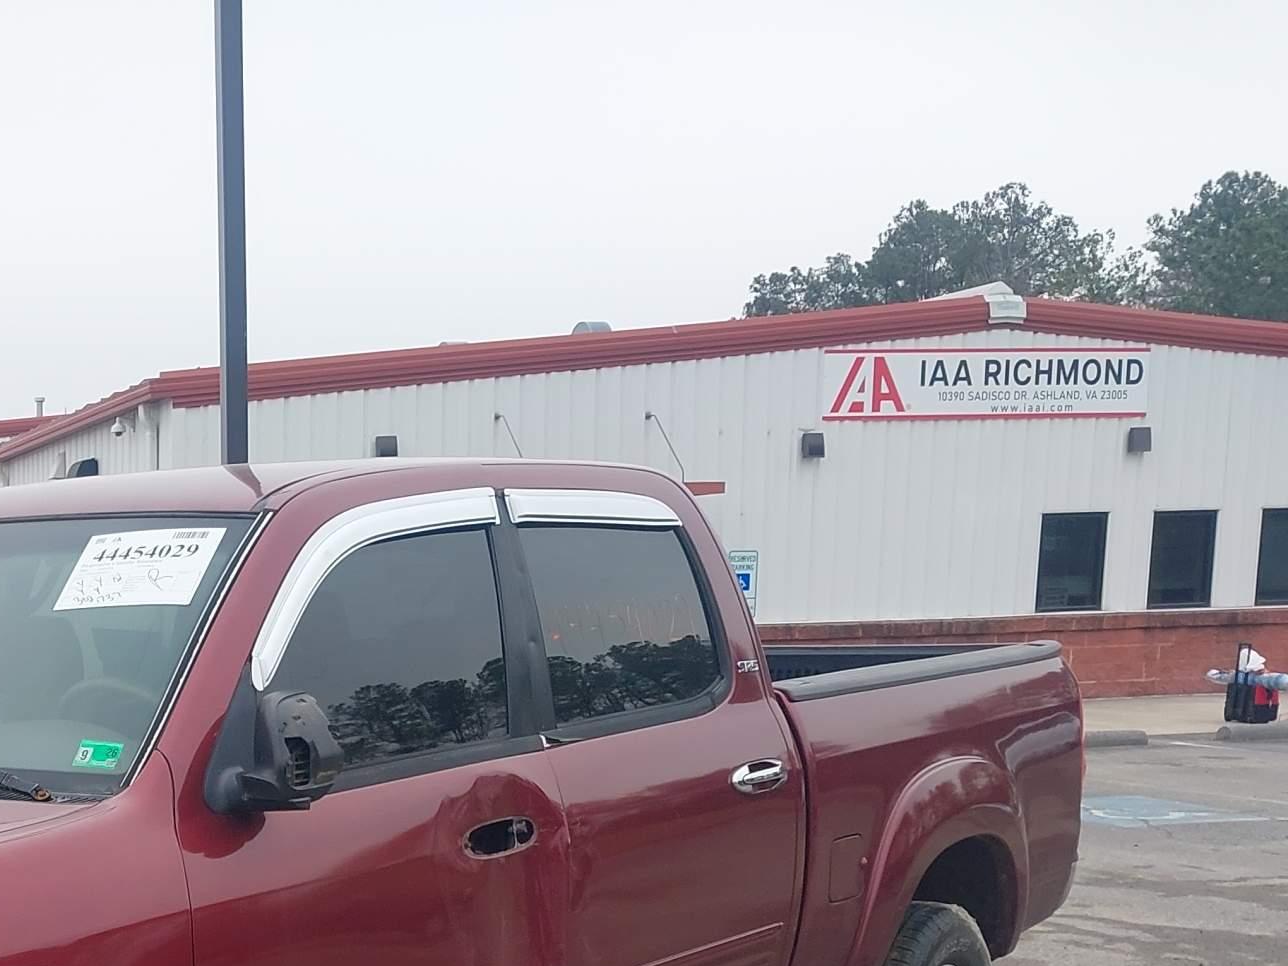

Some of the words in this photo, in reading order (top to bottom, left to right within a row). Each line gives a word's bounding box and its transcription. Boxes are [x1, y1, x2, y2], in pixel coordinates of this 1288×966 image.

[919, 359, 973, 387] IAA
[983, 358, 1144, 386] RICHMOND
[938, 391, 965, 401] 10390
[968, 391, 1011, 401] SADISCO
[1014, 390, 1028, 400] DR.
[1032, 390, 1082, 401] ASHLAND,
[1085, 390, 1097, 400] VA
[1100, 389, 1128, 400] 23005
[990, 403, 1073, 412] www.iaai.com
[93, 543, 200, 562] 44454029
[80, 749, 89, 761] 9
